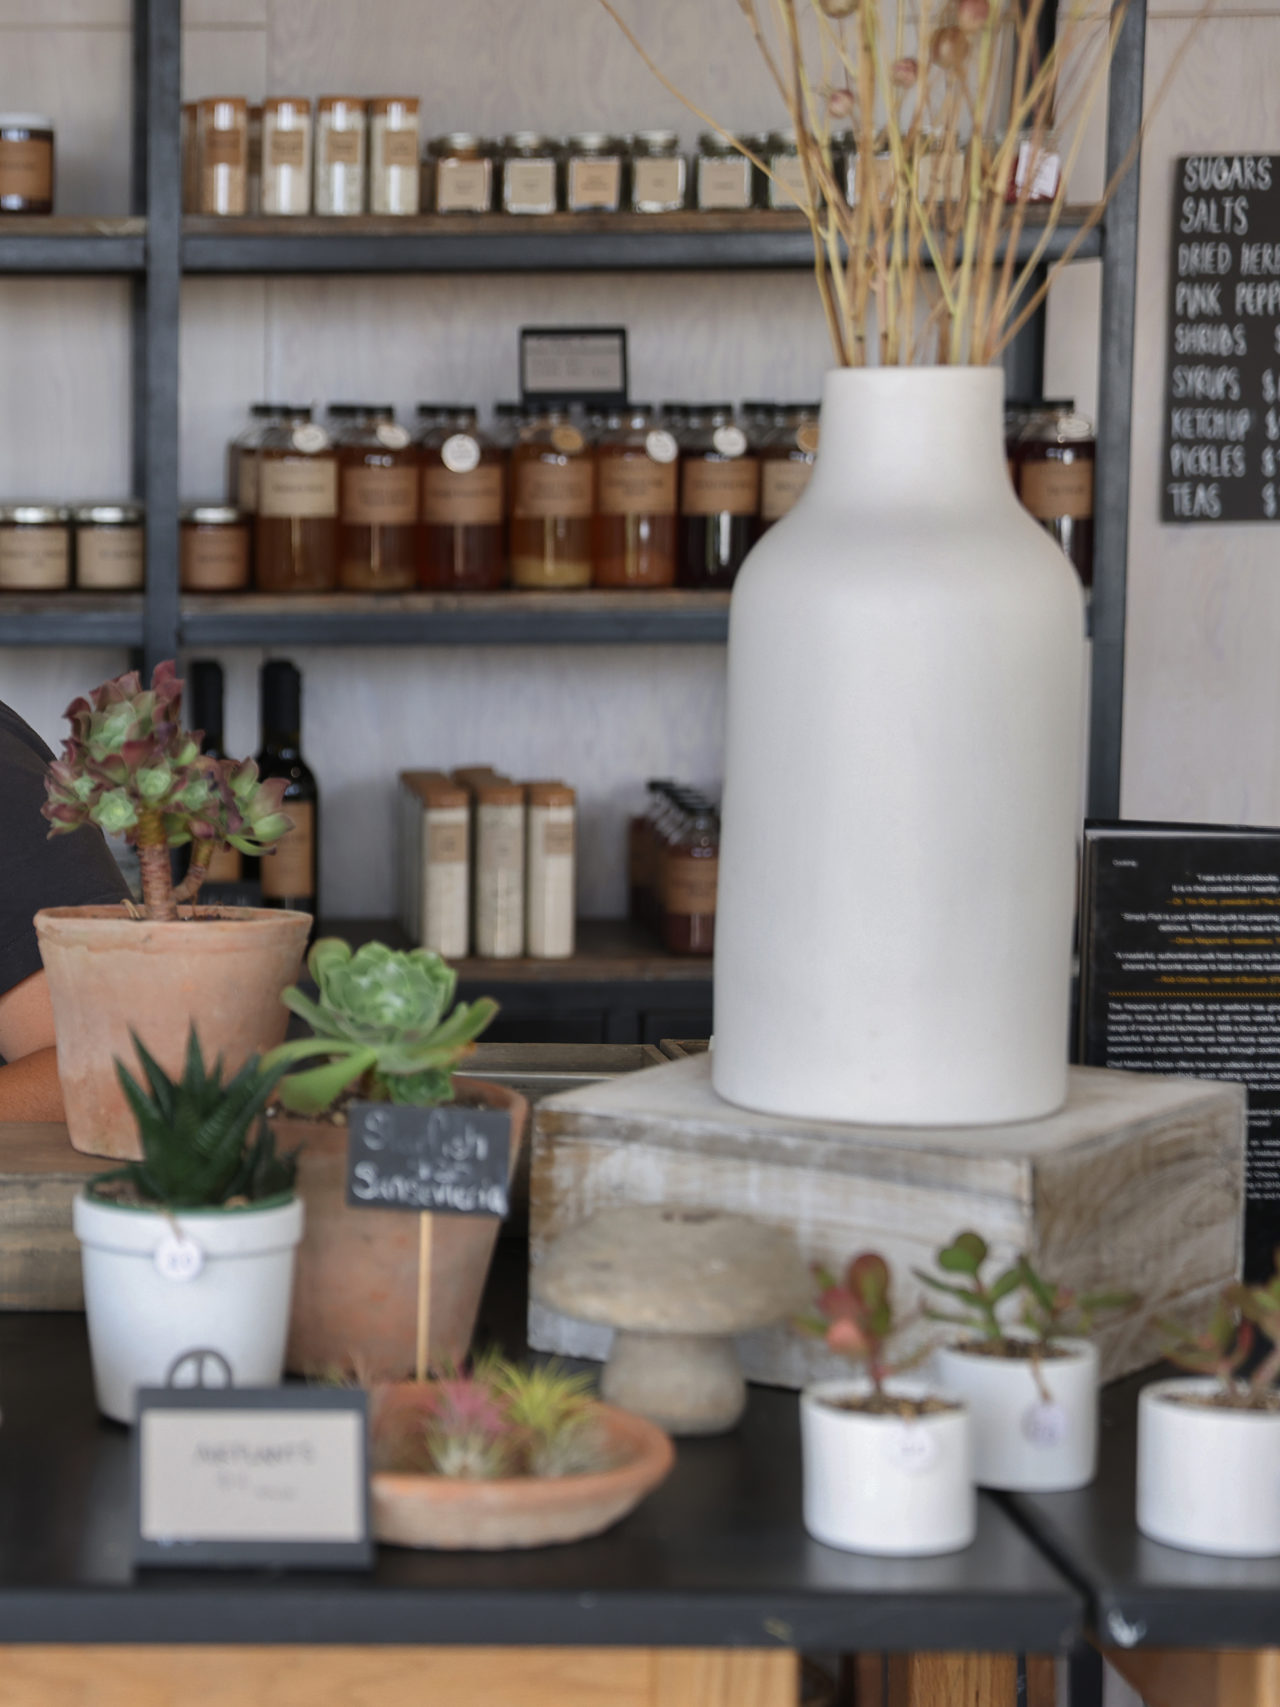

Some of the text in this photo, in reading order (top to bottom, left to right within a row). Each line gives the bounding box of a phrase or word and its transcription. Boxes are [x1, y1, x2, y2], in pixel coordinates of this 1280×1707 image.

[1183, 155, 1272, 192] SUGARS
[1180, 195, 1249, 236] SALTS
[1177, 242, 1231, 277] DRIED
[1176, 281, 1222, 320] PINK
[1172, 364, 1240, 401] SYRUPS
[1171, 407, 1250, 442] KETCHUP
[1170, 442, 1246, 478] PICKLES
[1167, 482, 1222, 518] TEAS
